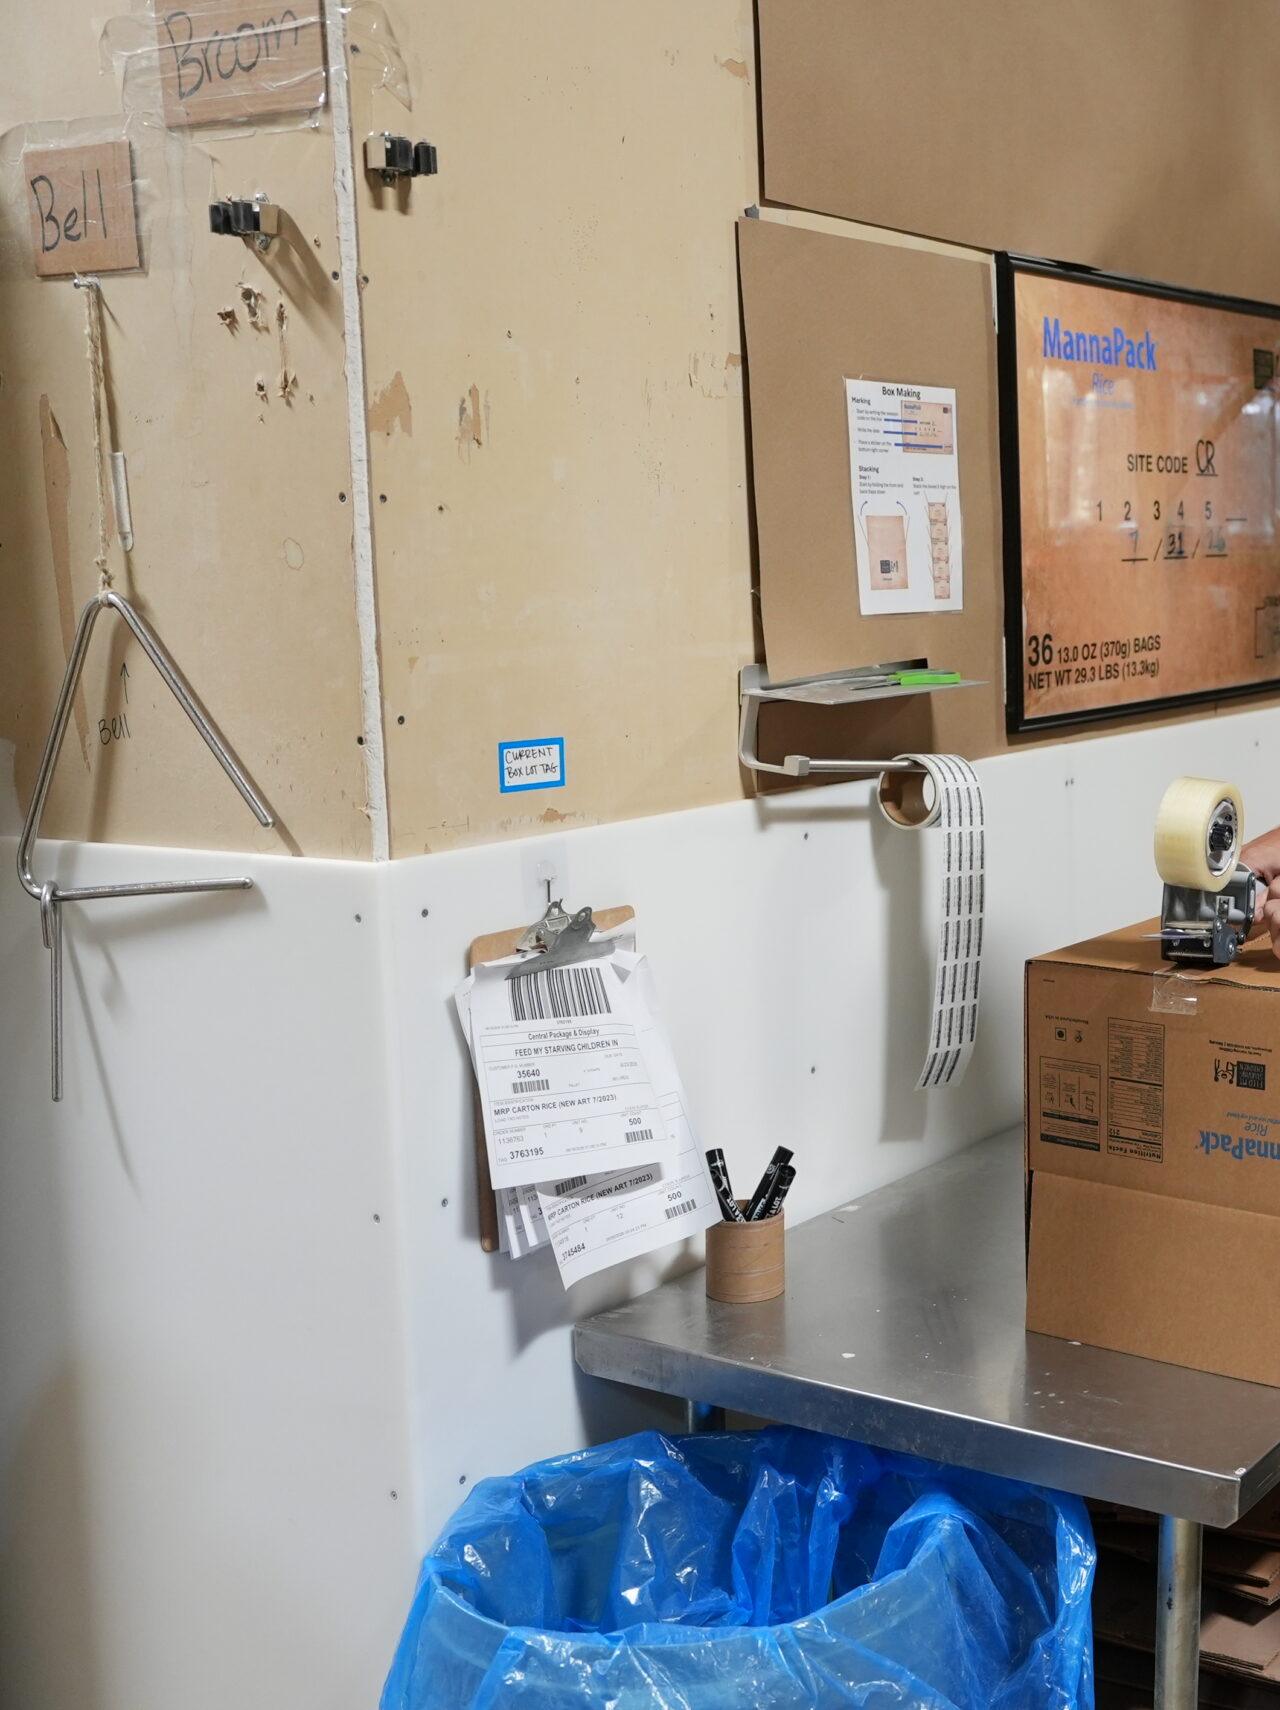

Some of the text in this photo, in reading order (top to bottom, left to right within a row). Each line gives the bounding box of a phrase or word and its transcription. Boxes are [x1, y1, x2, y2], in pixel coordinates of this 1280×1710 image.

[163, 10, 298, 100] Broom
[30, 168, 107, 254] Bell
[1043, 316, 1156, 371] MannaPack
[1092, 372, 1114, 395] Rice
[851, 397, 871, 405] Marking
[882, 386, 921, 400] Box Making
[858, 465, 880, 474] Stacking
[1127, 454, 1153, 472] SITE
[1156, 455, 1189, 474] CODE
[1096, 500, 1212, 521] 1 2 3 4 5
[1028, 633, 1161, 667] 36 13.0 OZ (370g) BAGS
[1028, 658, 1160, 691] NET WT 29.3 LBS (13.3kg)
[98, 713, 131, 745] Bell
[505, 747, 553, 764] CURRENT
[505, 763, 558, 779] BOX LOT TAG
[528, 1027, 600, 1041] Central Package & Display
[515, 1039, 619, 1057] FEED MY STARVING CHILDREN IN
[516, 1068, 541, 1079] 35640
[494, 1094, 617, 1116] MRP CARTON RICE (NEW ART 7/2023)
[628, 1117, 642, 1126] 500
[1244, 1121, 1268, 1137] Rice
[509, 1147, 544, 1160] 3763195
[1129, 1147, 1162, 1160] Nutrition
[556, 1201, 580, 1217] CARTON
[580, 1193, 595, 1206] RICE
[596, 1187, 614, 1201] (NEW
[614, 1181, 629, 1193] ART
[629, 1173, 654, 1186] 7/2023)
[667, 1191, 682, 1202] 500
